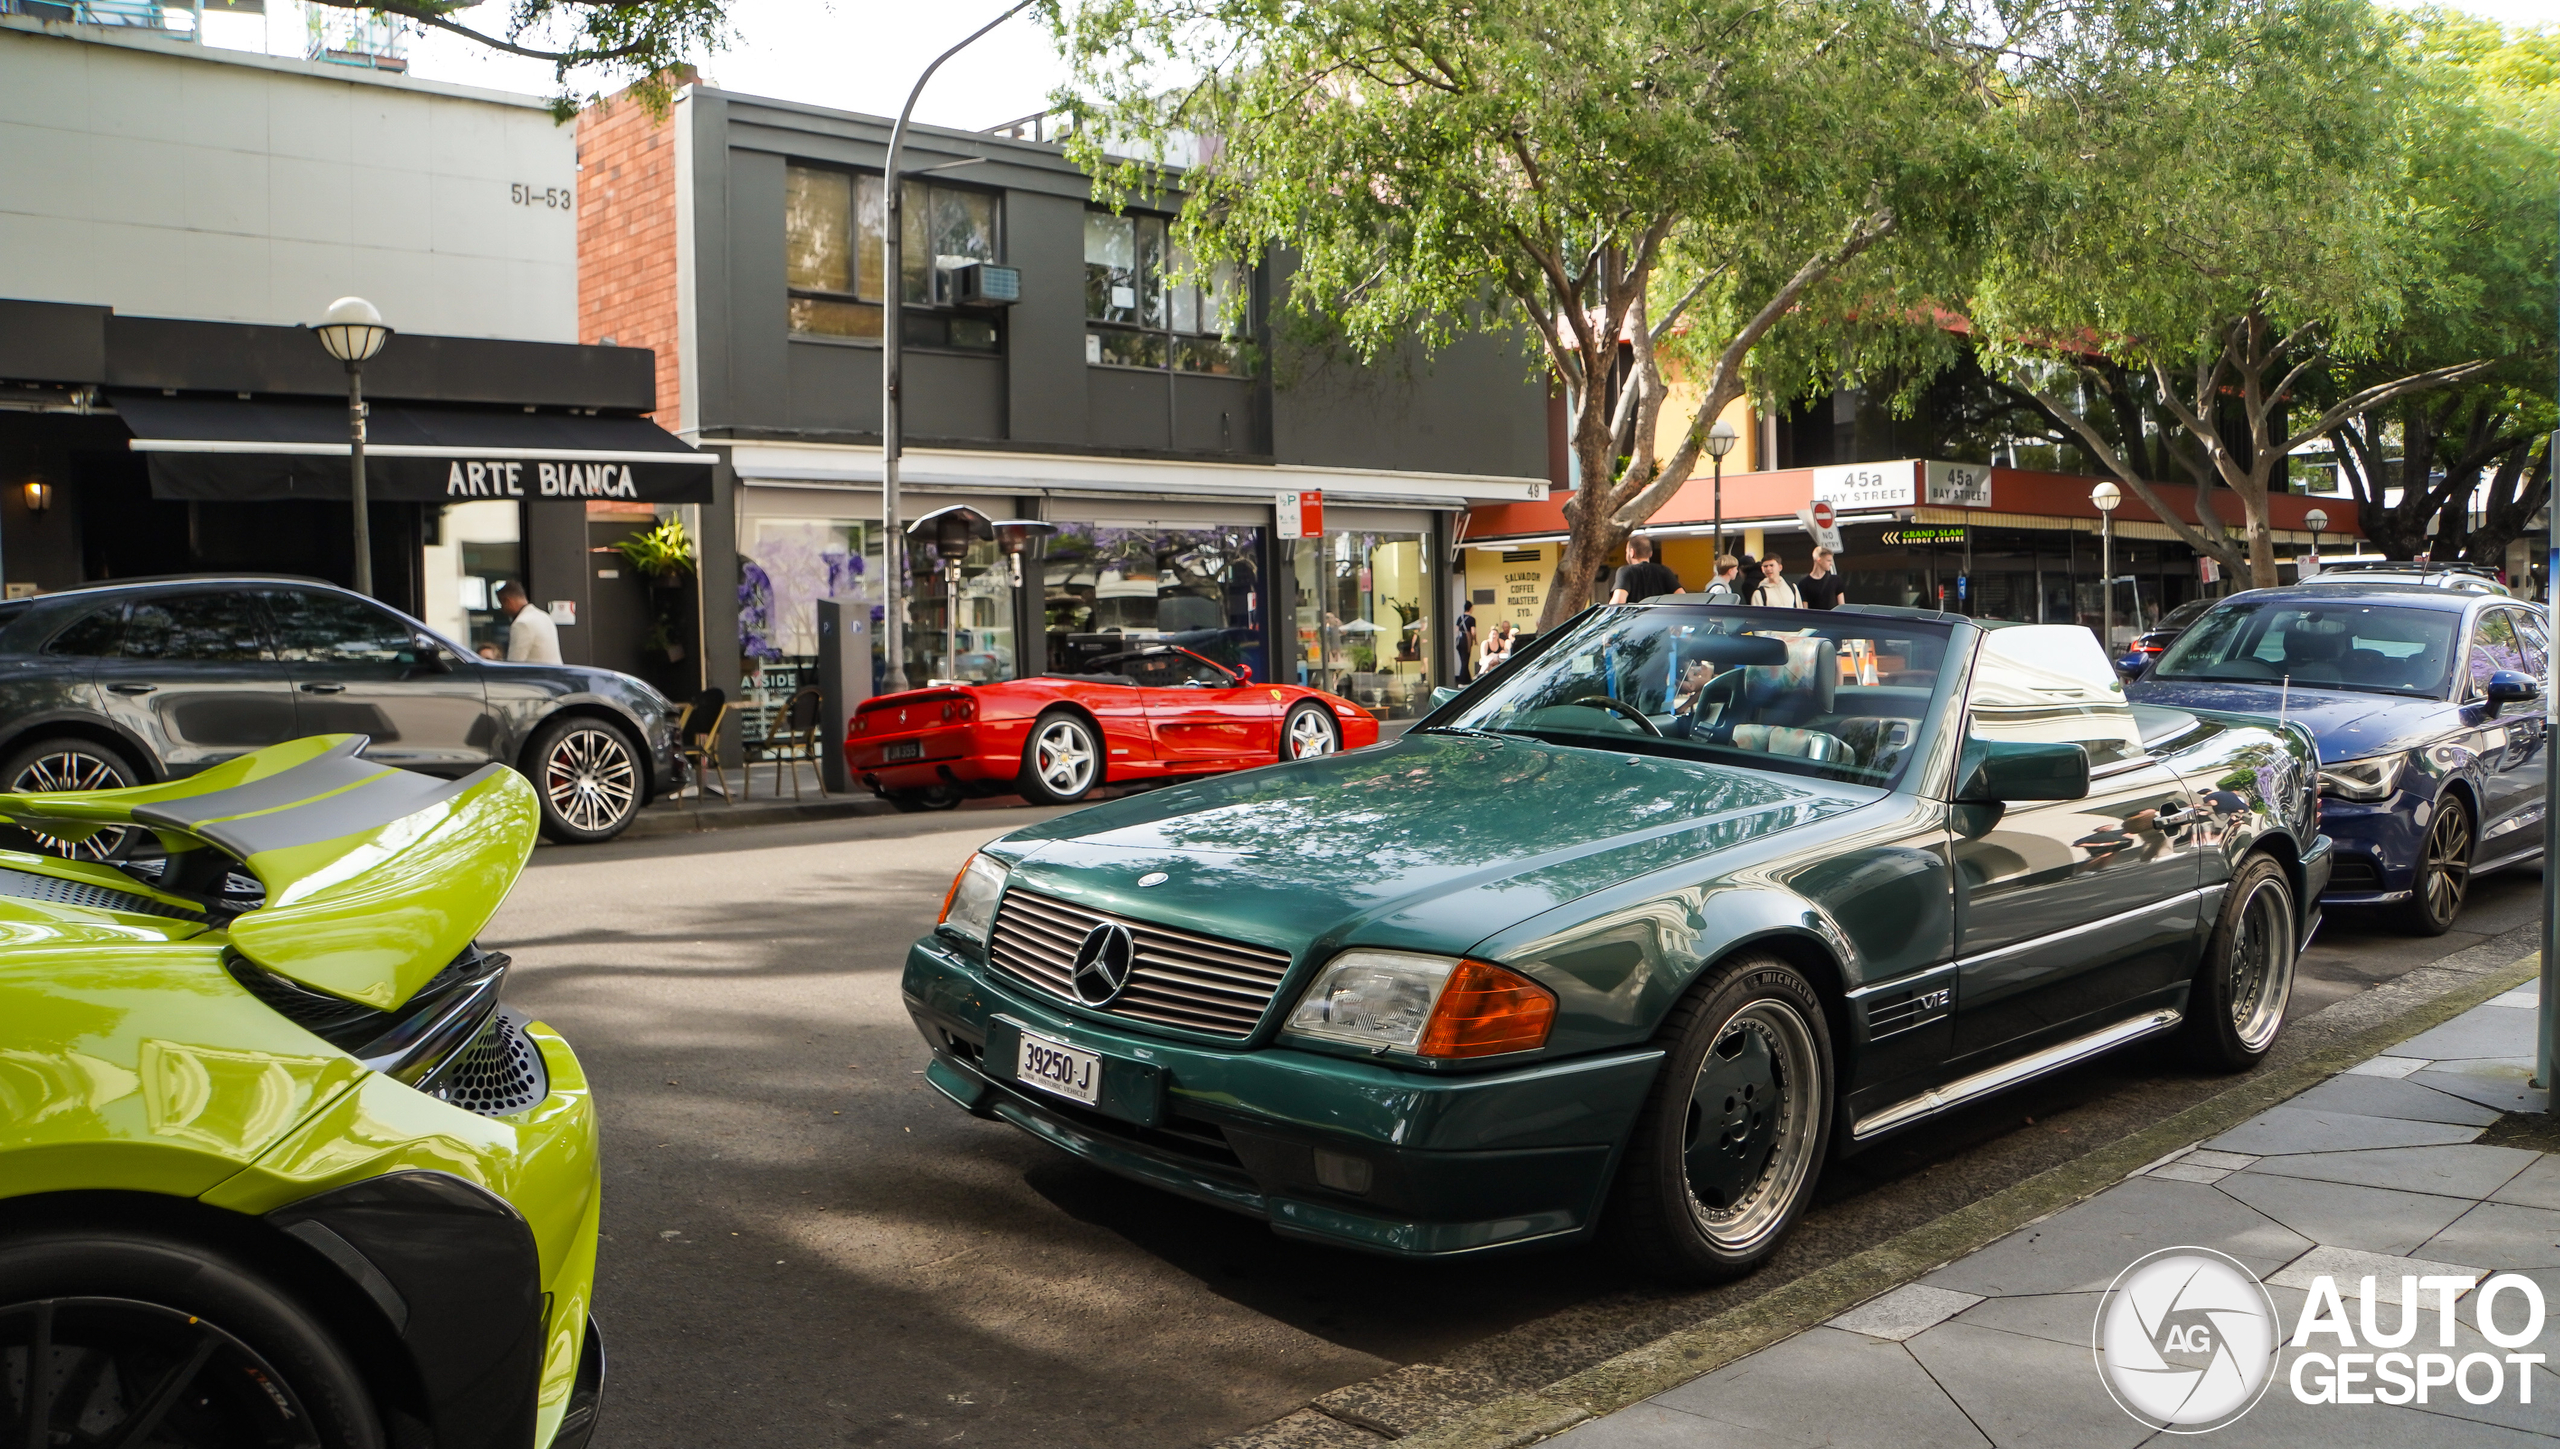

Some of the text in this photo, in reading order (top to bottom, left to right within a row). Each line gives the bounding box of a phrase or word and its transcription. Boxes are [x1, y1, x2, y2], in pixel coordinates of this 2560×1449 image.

[511, 183, 571, 210] 51-53
[447, 461, 638, 498] ARTE BIANCA
[1844, 472, 1883, 488] 45a
[1947, 469, 1973, 486] 45a
[1527, 483, 1540, 498] 49
[1854, 488, 1907, 502] STREET
[1933, 488, 1987, 502] BAY STREET
[1823, 531, 1834, 540] NO
[1902, 529, 1964, 539] GRAND SLAM
[1504, 572, 1541, 584] SALVADOR
[1510, 584, 1535, 594] COFFEE
[1507, 596, 1539, 605] ROASTERS
[1516, 608, 1533, 617] SYD.
[740, 673, 796, 689] AYSIDE
[1762, 972, 1815, 1006] MICHELIN
[1920, 990, 1950, 1010] V12
[1038, 1077, 1063, 1091] HISTORIC
[1063, 1085, 1088, 1099] VEHICLE
